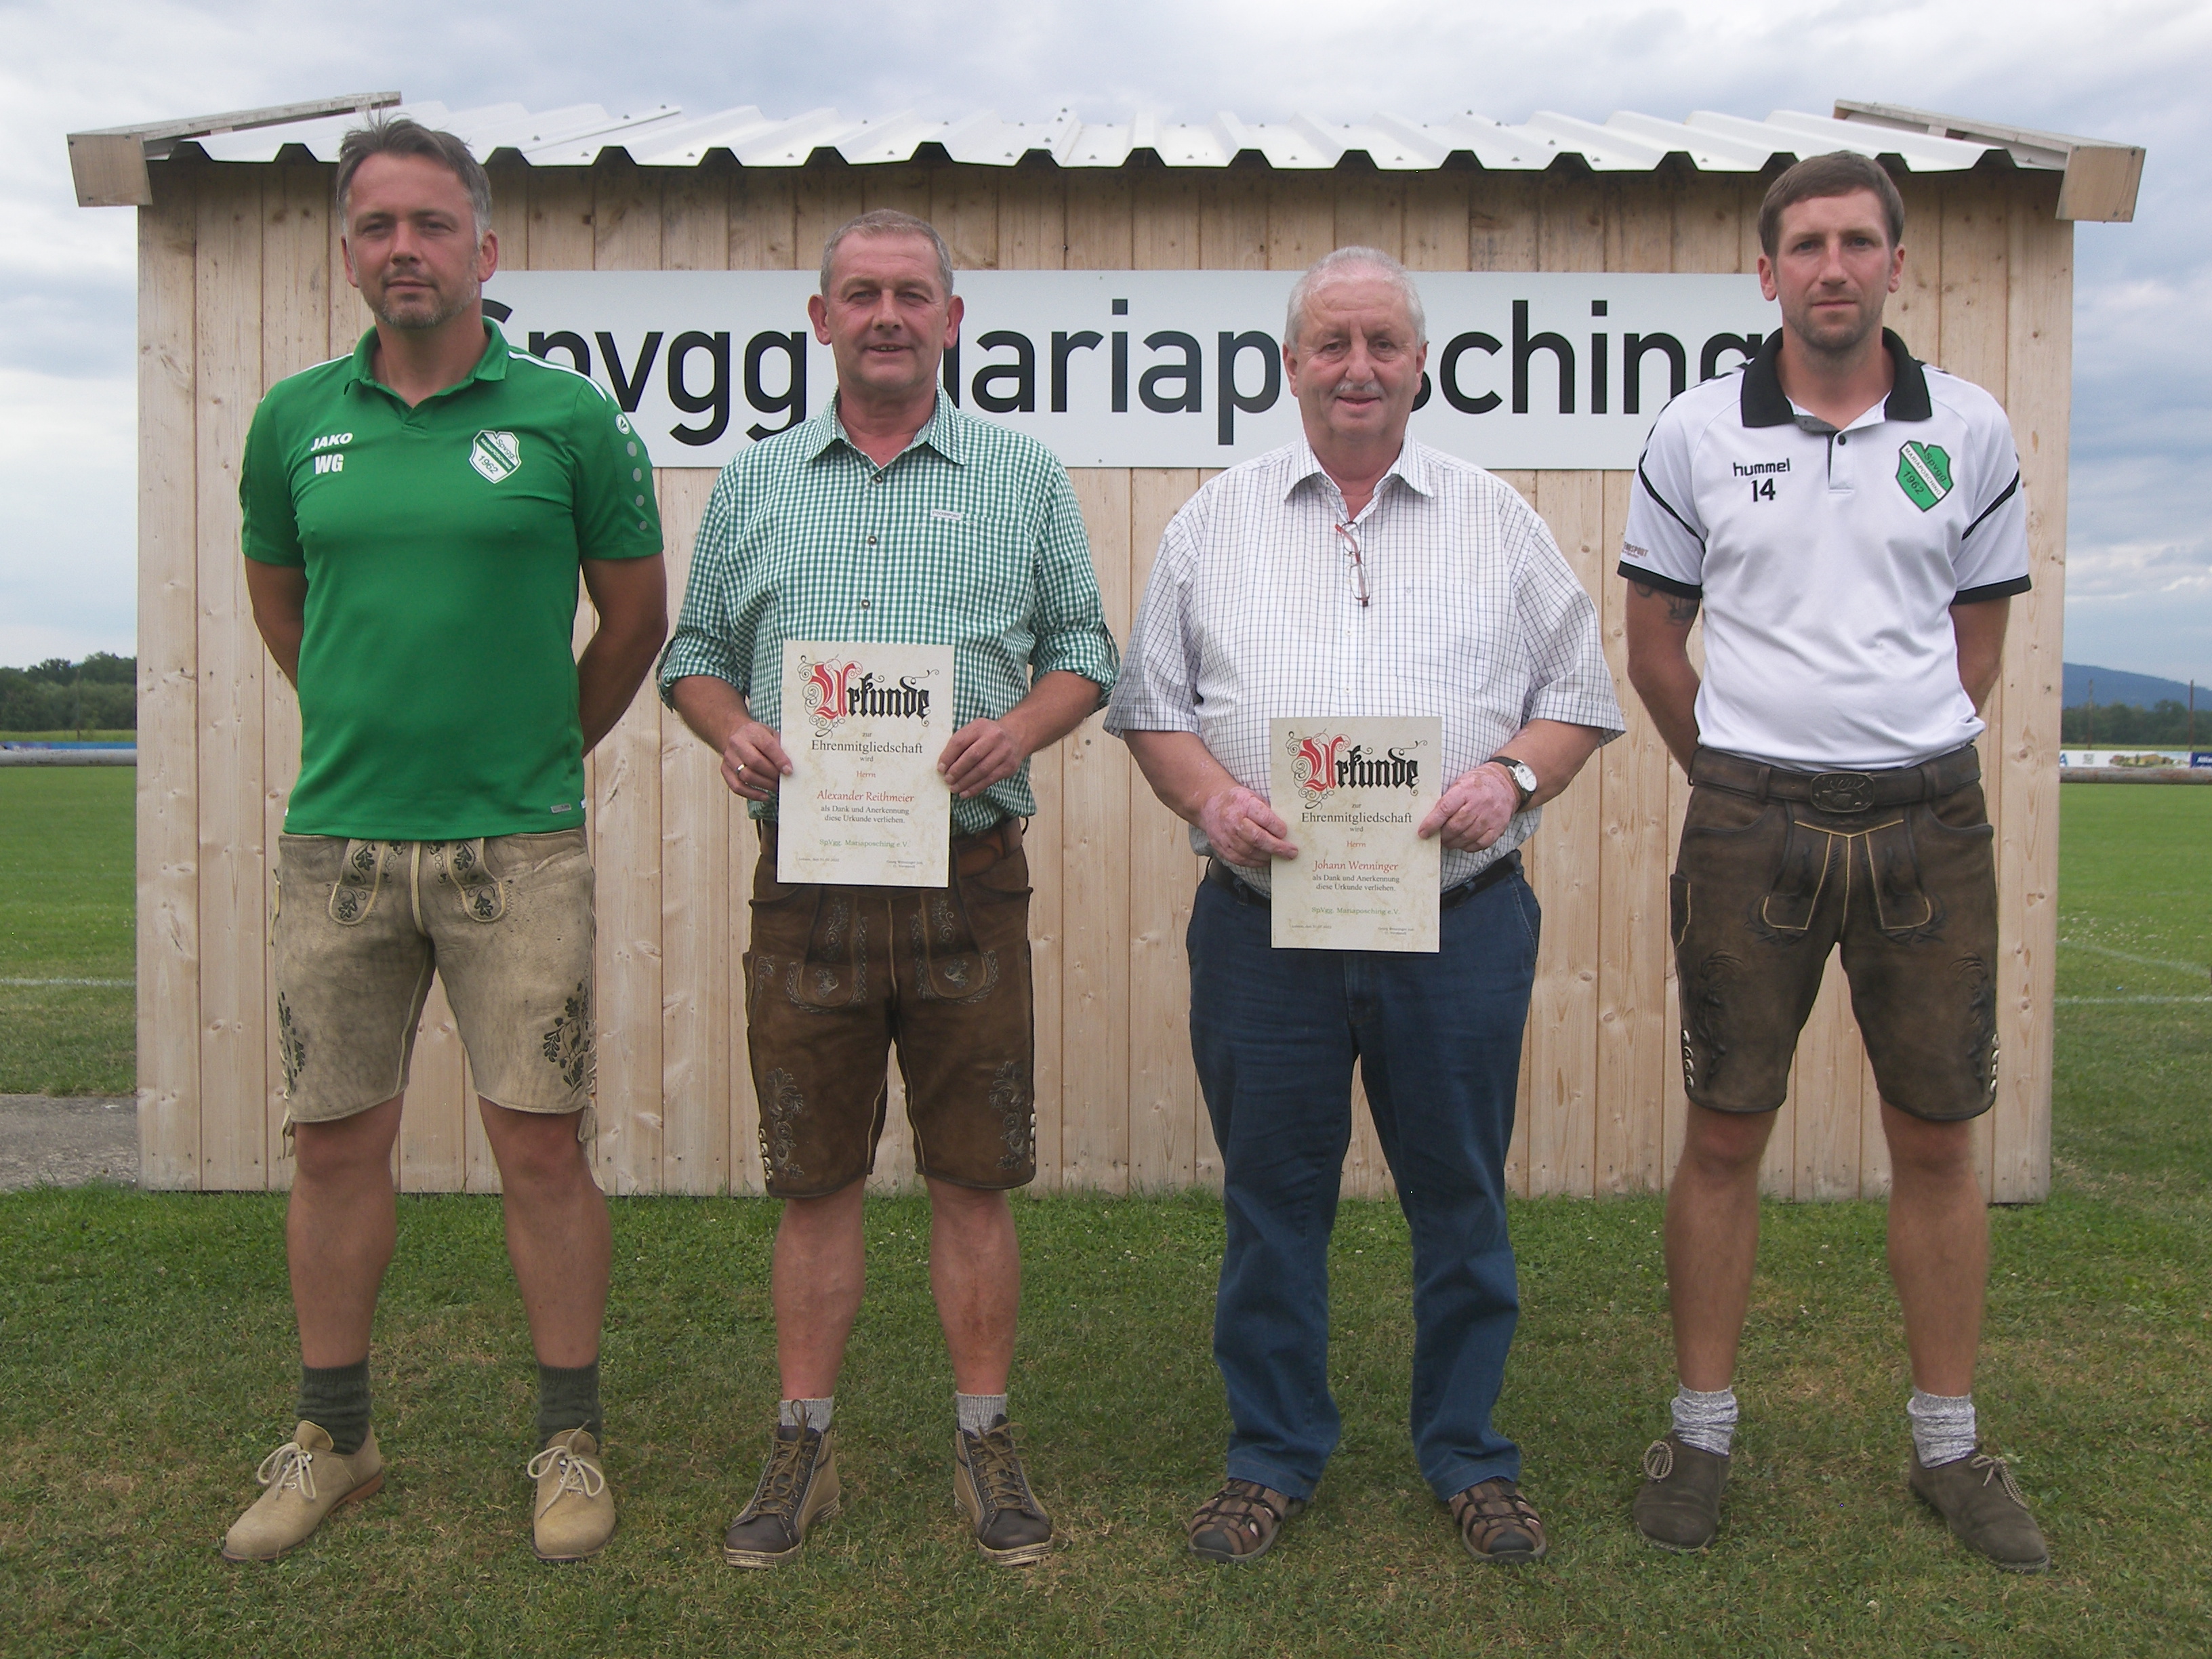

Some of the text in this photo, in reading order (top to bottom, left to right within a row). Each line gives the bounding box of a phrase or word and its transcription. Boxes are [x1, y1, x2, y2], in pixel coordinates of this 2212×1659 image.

[310, 432, 353, 452] JAKO
[315, 453, 344, 474] WG
[478, 455, 498, 474] 1962
[1733, 457, 1790, 477] hummel
[1905, 447, 1942, 495] MARIAPOSCHING
[1750, 478, 1776, 502] 14
[1903, 470, 1925, 495] 1962
[799, 656, 935, 729] Urkunde
[812, 739, 922, 754] Ehrenmitgliedschaft
[1289, 731, 1422, 801] Urkunde
[817, 790, 914, 802] Alexander Reithmeier
[866, 806, 909, 815] Anerkennung
[1301, 812, 1412, 824] Ehrenmitgliedschaft
[1313, 861, 1398, 873] Johann Wenninger
[1356, 876, 1399, 884] Anerkennung
